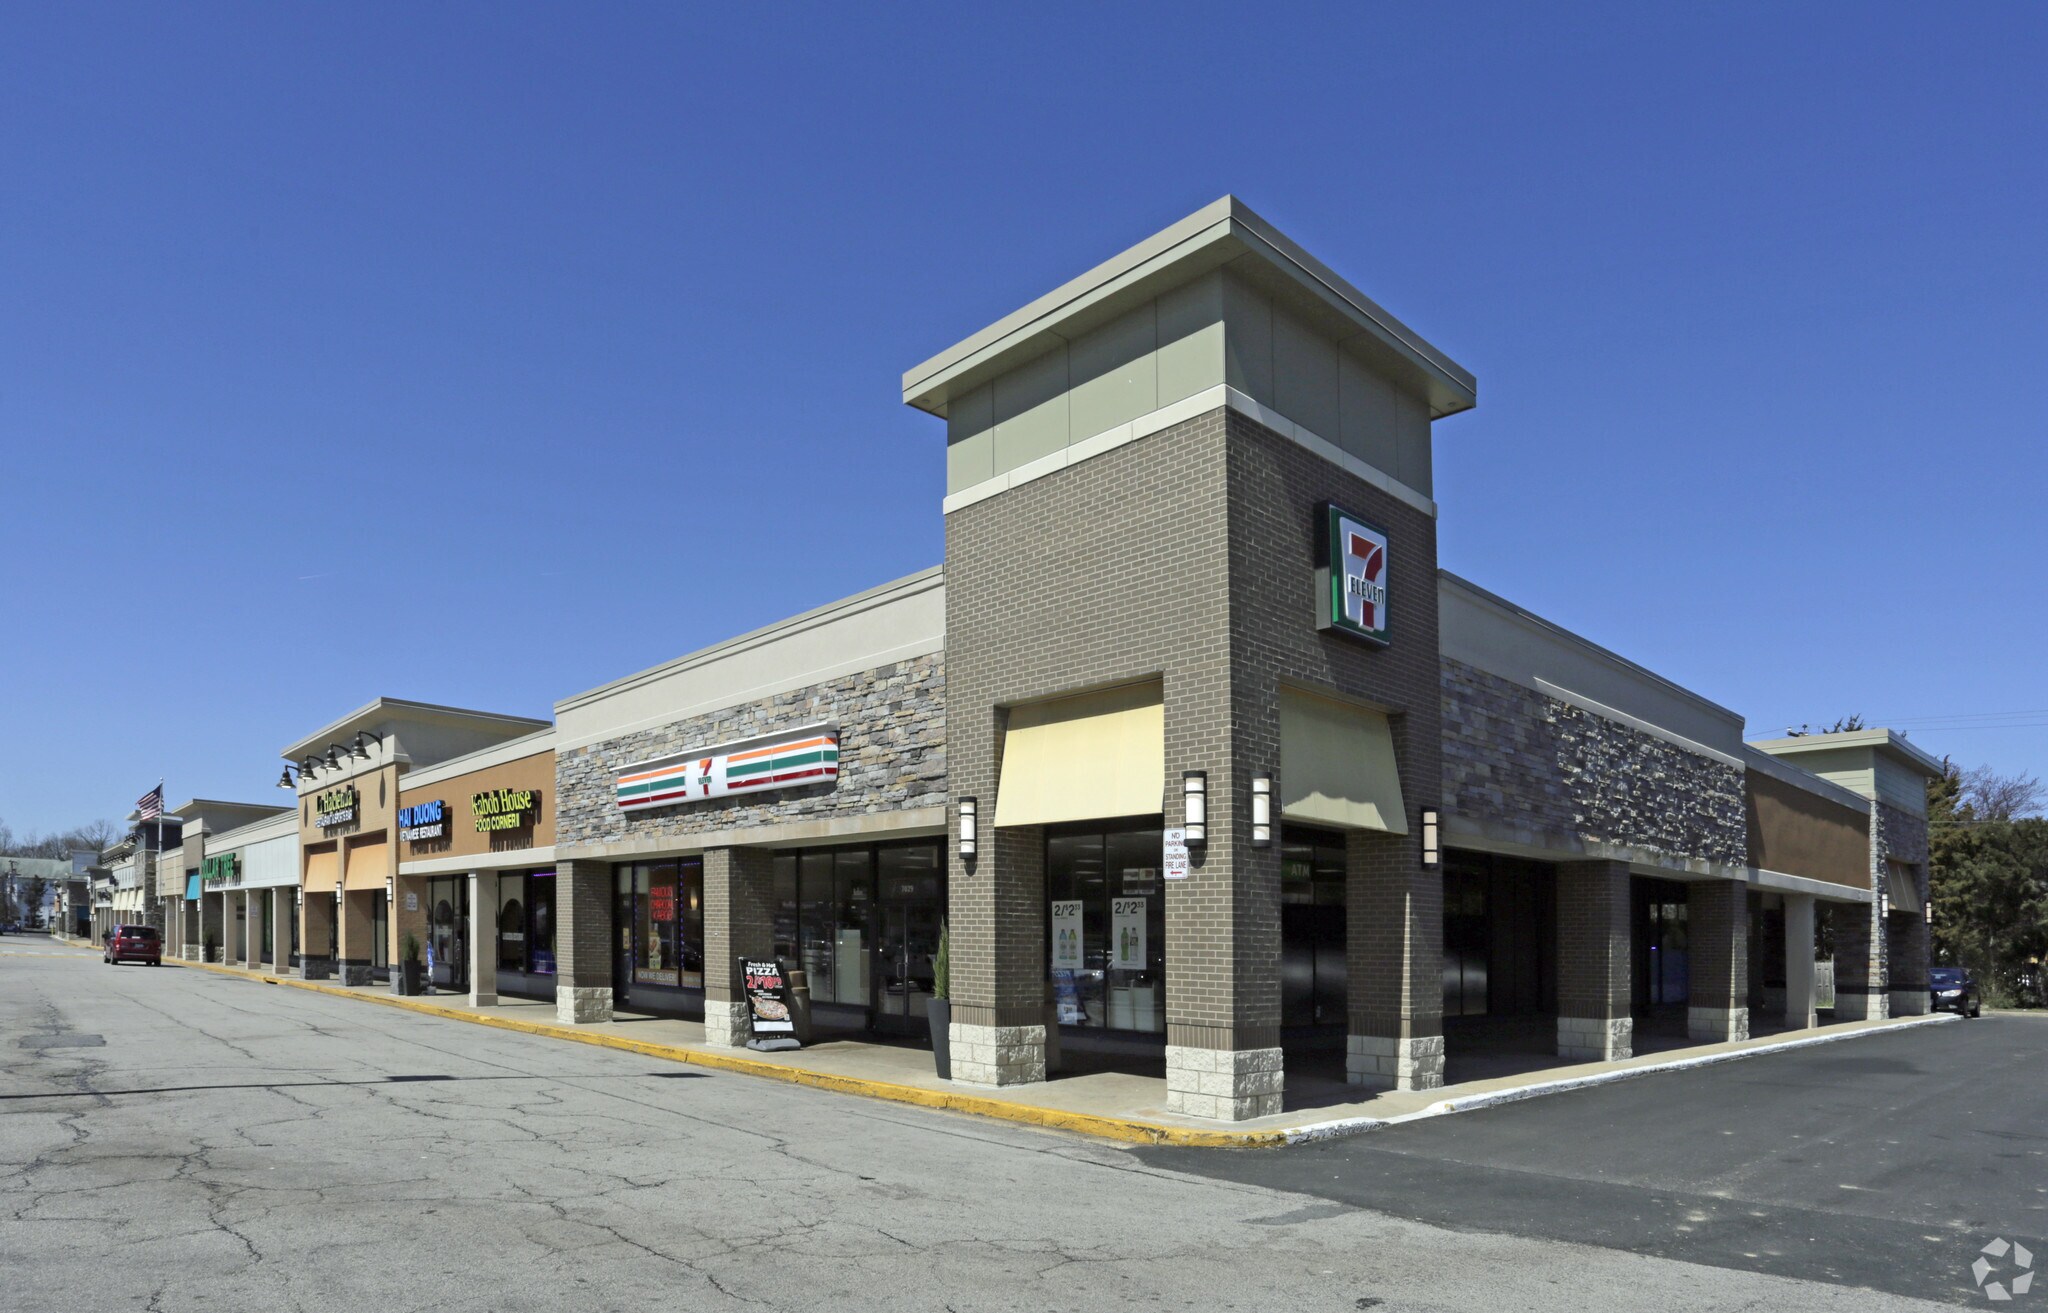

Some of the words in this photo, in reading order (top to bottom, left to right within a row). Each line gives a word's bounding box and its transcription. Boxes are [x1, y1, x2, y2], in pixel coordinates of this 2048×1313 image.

[1349, 531, 1383, 629] 7
[699, 758, 713, 795] 7
[398, 807, 411, 828] HAI
[413, 800, 442, 825] DUONG
[470, 791, 500, 815] Kabob
[499, 789, 531, 812] House
[475, 817, 491, 832] FOOD
[491, 814, 516, 829] CORNER
[220, 853, 234, 877] TREE
[1165, 861, 1175, 869] FIRE
[1175, 861, 1187, 869] LANE
[1291, 864, 1310, 877] ATM
[745, 966, 780, 976] PIZZA
